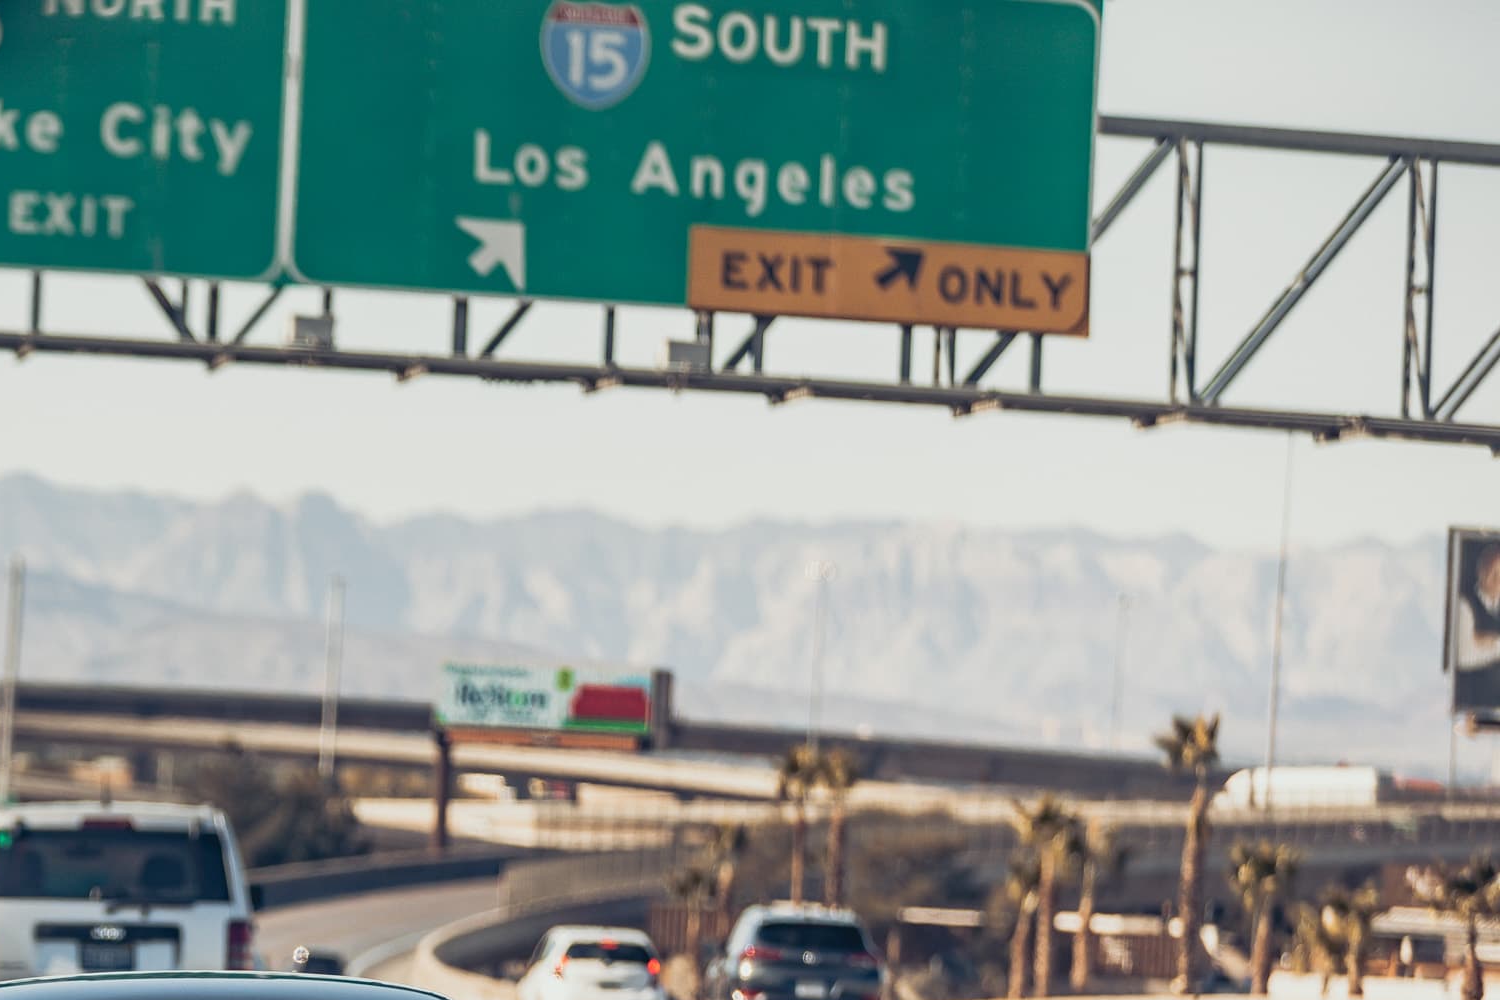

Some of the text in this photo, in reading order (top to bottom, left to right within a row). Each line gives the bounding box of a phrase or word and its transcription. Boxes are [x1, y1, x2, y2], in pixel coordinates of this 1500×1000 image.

[565, 4, 888, 90] 15 SOUTH
[101, 102, 252, 175] City
[473, 128, 916, 216] Los Angeles
[8, 193, 134, 239] EXIT
[720, 250, 1073, 310] EXIT ONLY
